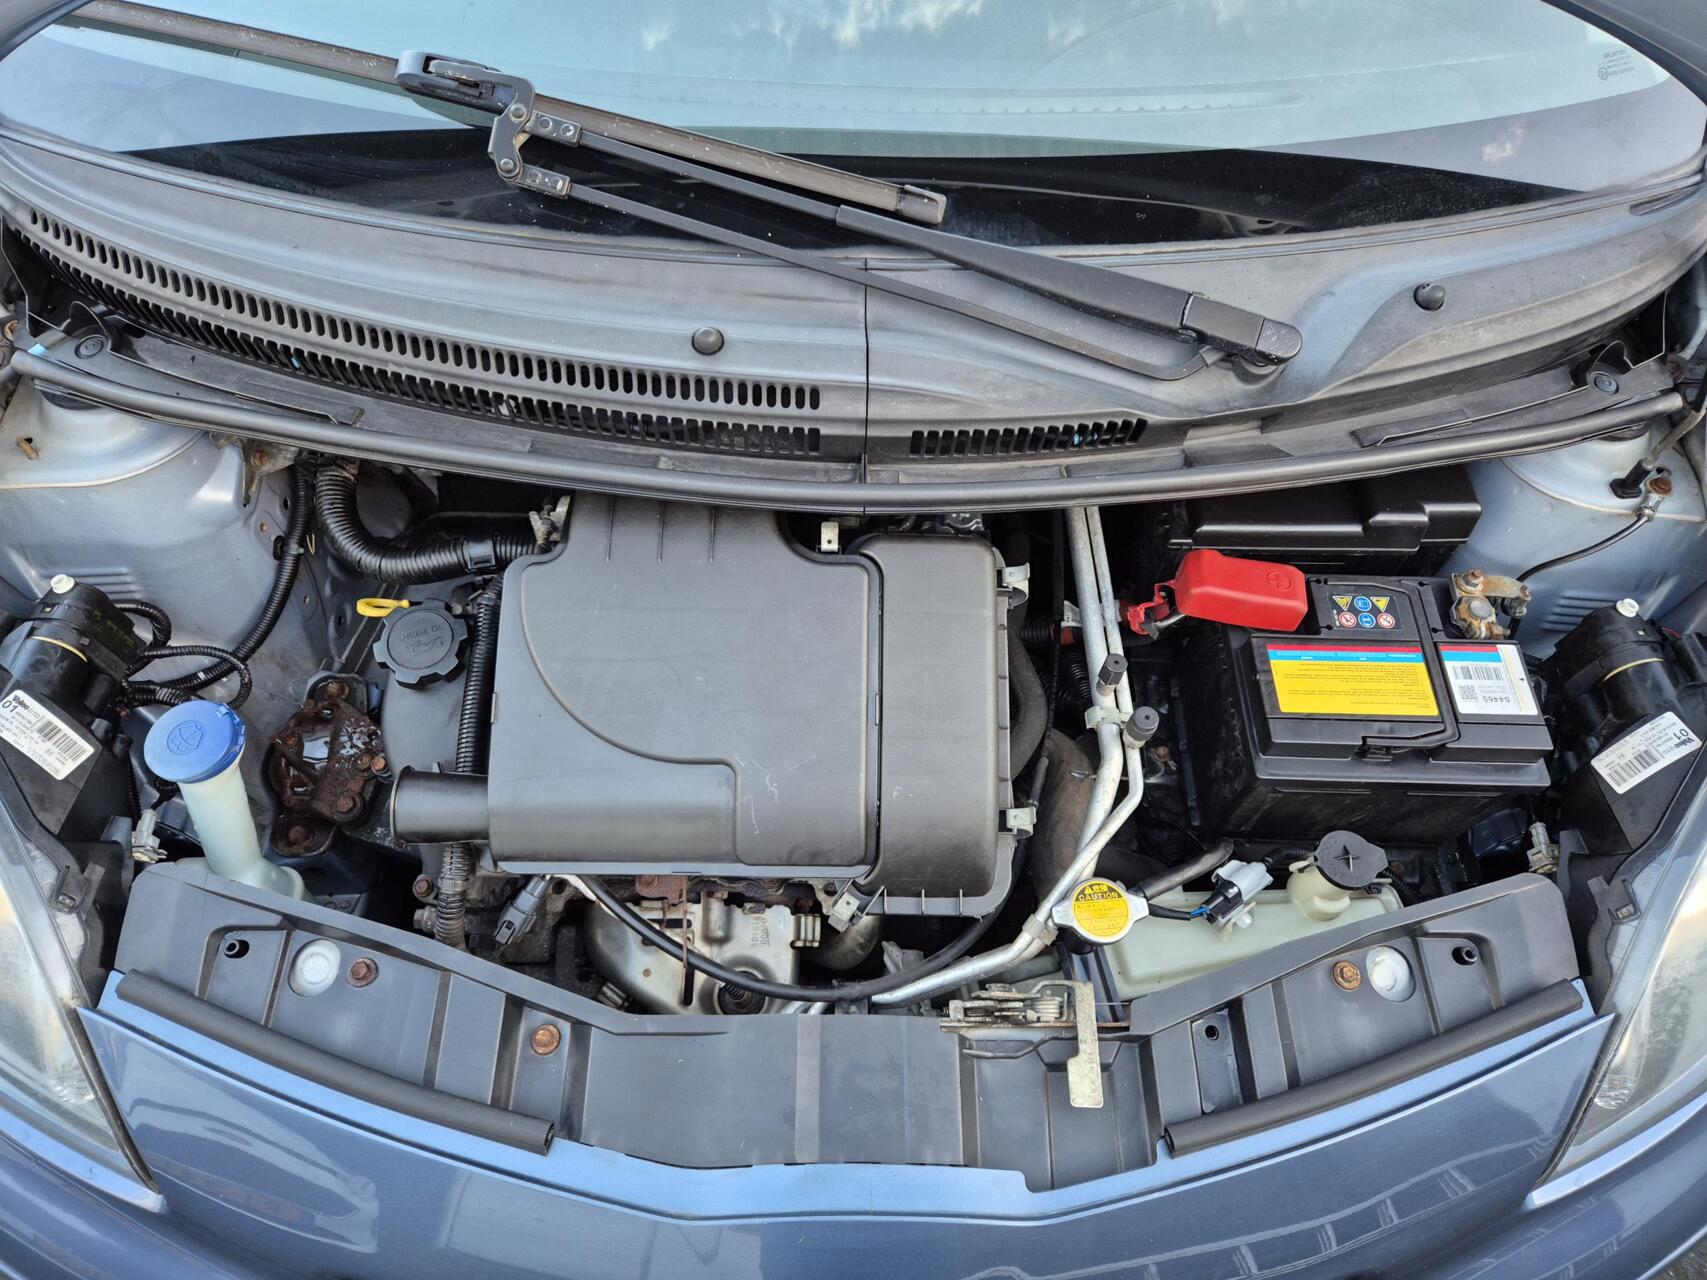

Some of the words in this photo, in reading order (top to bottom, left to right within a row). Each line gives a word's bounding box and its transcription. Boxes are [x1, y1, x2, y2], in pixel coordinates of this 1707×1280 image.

[12, 695, 30, 711] Valeo
[1482, 695, 1511, 703] 54465
[1, 700, 18, 713] 01
[1673, 728, 1689, 741] 01
[1674, 737, 1695, 749] Valeo
[1078, 891, 1119, 902] CAUTION
